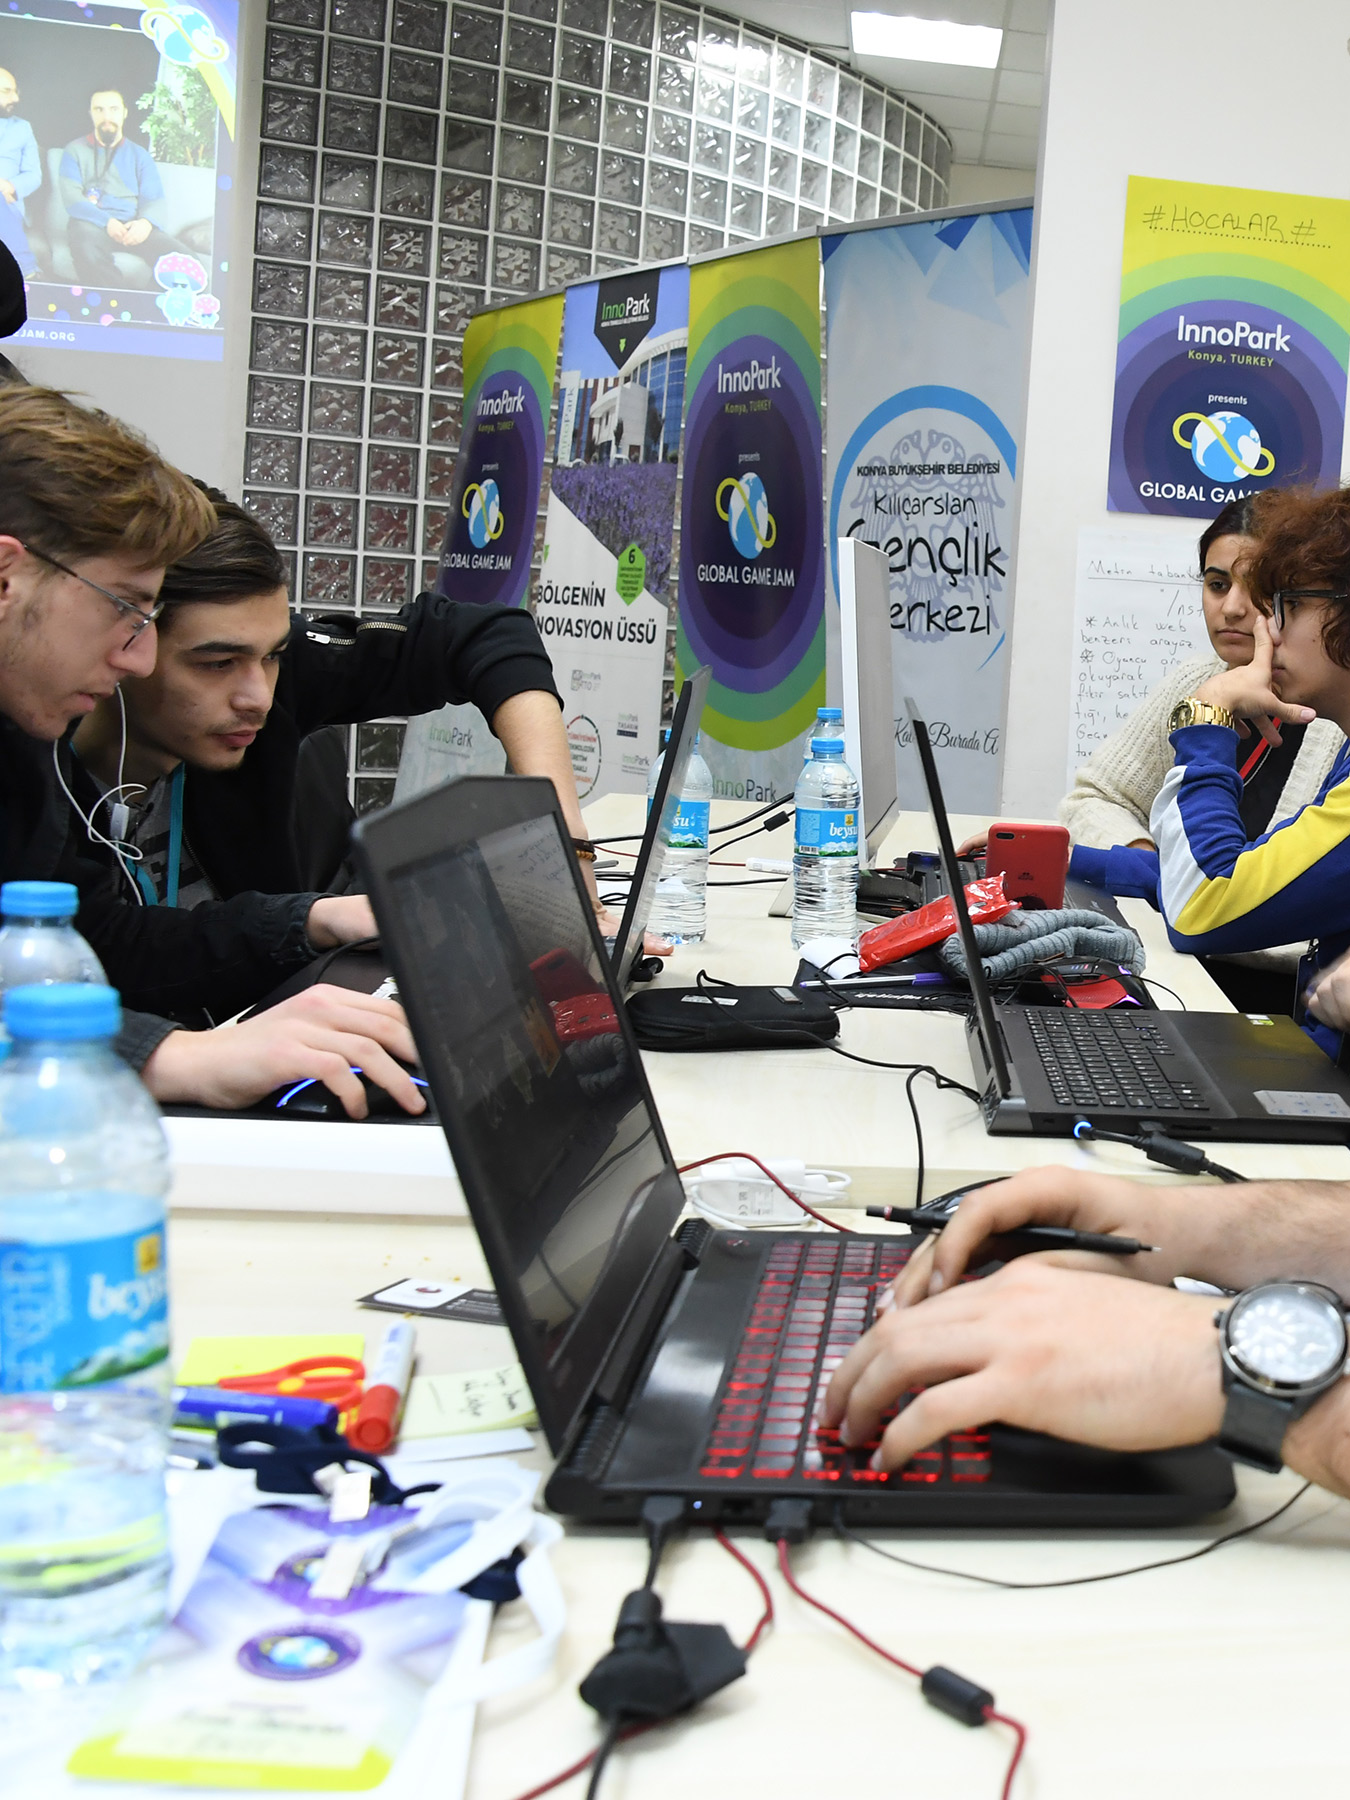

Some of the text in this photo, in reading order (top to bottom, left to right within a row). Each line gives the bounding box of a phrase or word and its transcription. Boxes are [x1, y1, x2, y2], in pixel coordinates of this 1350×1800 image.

[602, 293, 651, 321] InnoPark
[1177, 315, 1292, 353] InnoPark
[1188, 349, 1275, 368] Konya, TURKEY
[718, 356, 782, 394] InnoPark
[477, 386, 526, 417] InnoPark
[1207, 393, 1249, 407] presents
[856, 465, 888, 477] KONYA
[949, 460, 1001, 476] BELEDİYESİ
[1139, 481, 1262, 504] GLOBAL GAM
[471, 553, 496, 570] GAME
[494, 554, 513, 571] JAM
[628, 548, 636, 565] 6
[697, 563, 796, 588] GLOBAL GAME JAM
[890, 594, 991, 636] erkezi
[536, 616, 657, 645] NOVASYON ÜSSÜ
[928, 721, 981, 751] Burada
